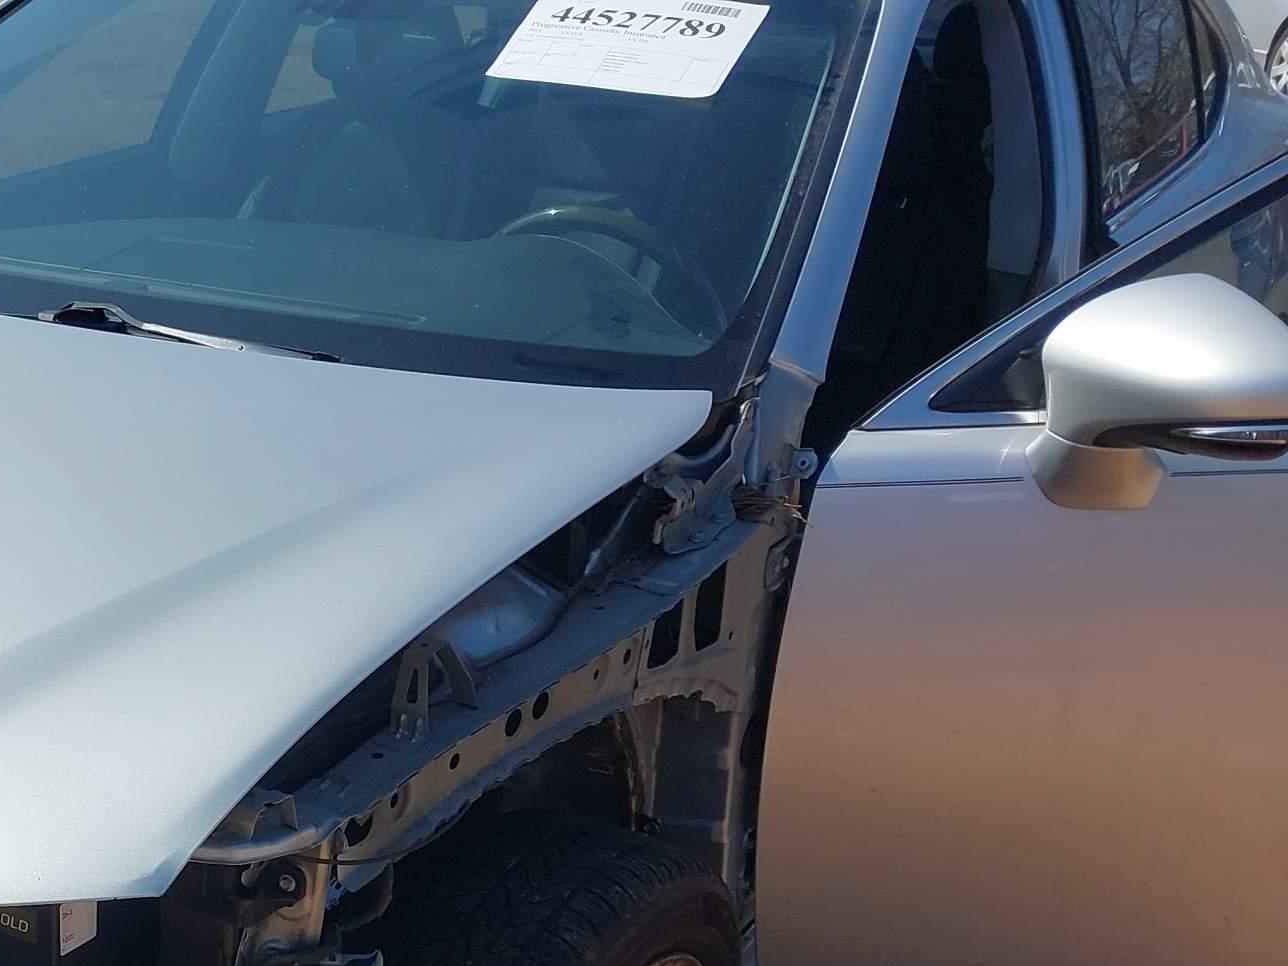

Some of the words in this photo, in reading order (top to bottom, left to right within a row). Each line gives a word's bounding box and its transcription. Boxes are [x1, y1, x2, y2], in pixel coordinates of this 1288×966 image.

[530, 21, 582, 31] Progressive
[583, 25, 621, 35] Casualty
[623, 30, 667, 40] Insurance
[551, 5, 726, 39] 44527789
